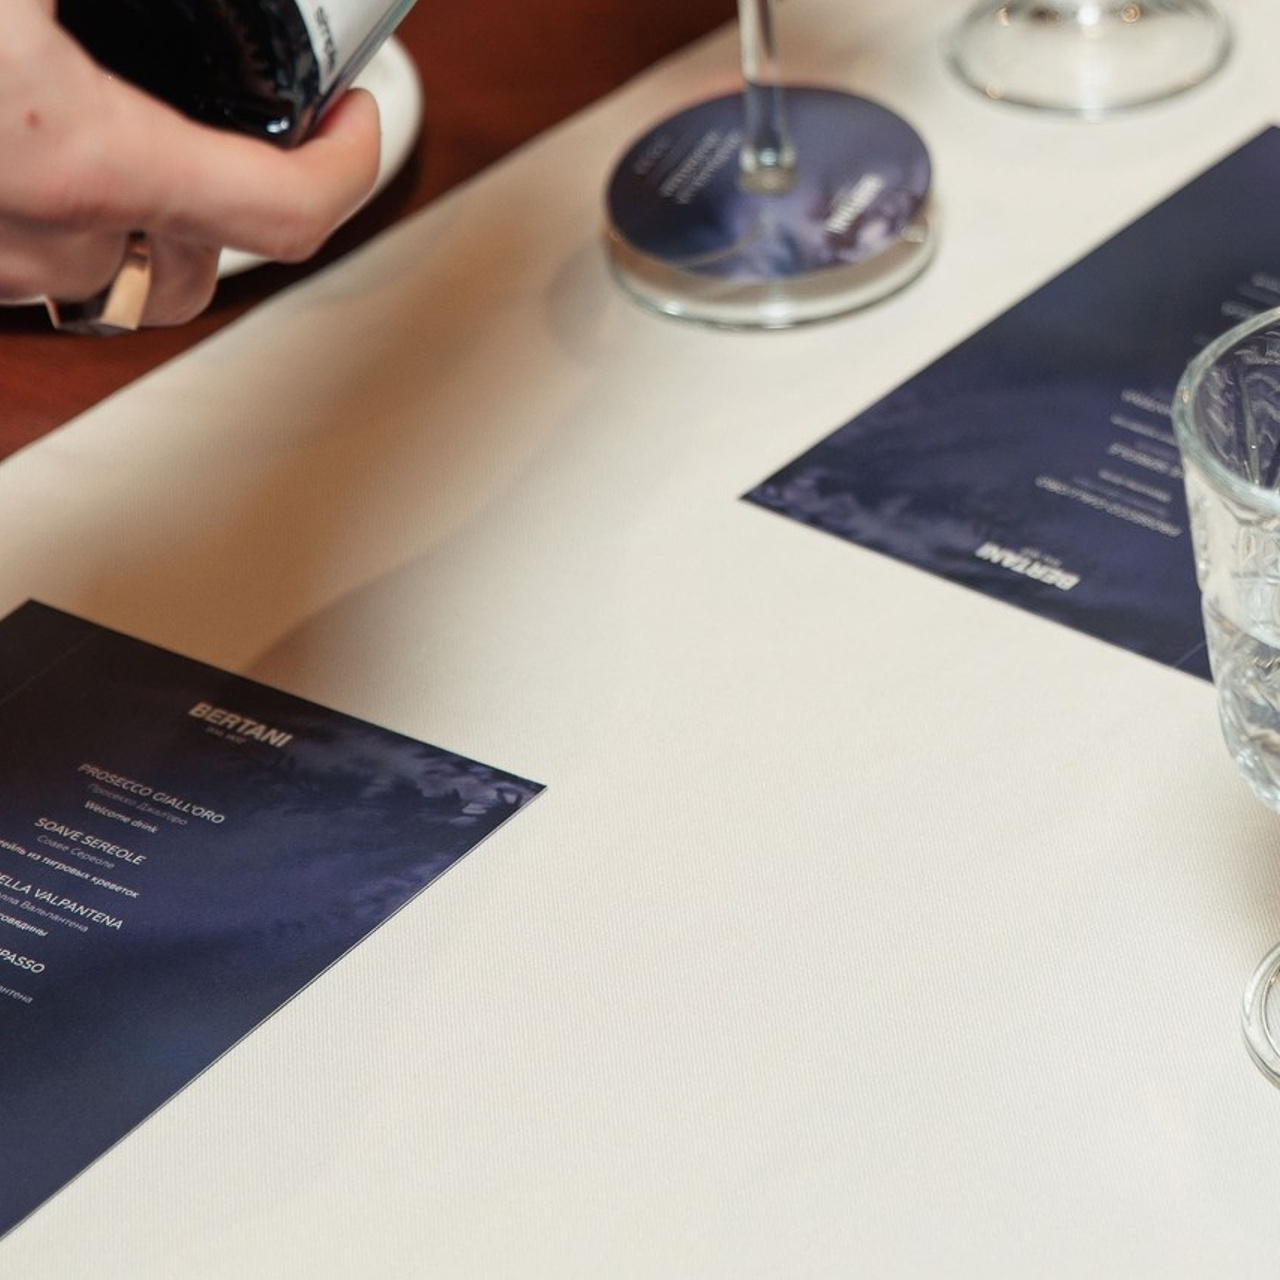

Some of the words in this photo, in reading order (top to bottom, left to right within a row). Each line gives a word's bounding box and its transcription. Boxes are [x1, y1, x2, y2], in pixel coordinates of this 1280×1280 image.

[187, 701, 294, 748] BERTANI
[78, 763, 153, 797] PROSECCO
[84, 800, 132, 824] Welcome
[130, 819, 159, 834] drink
[34, 817, 83, 841] SOAVE
[80, 835, 147, 866] SEREOLE
[0, 872, 32, 895] ELLA
[34, 888, 124, 930] VALPANTENA
[0, 948, 46, 974] PASSO
